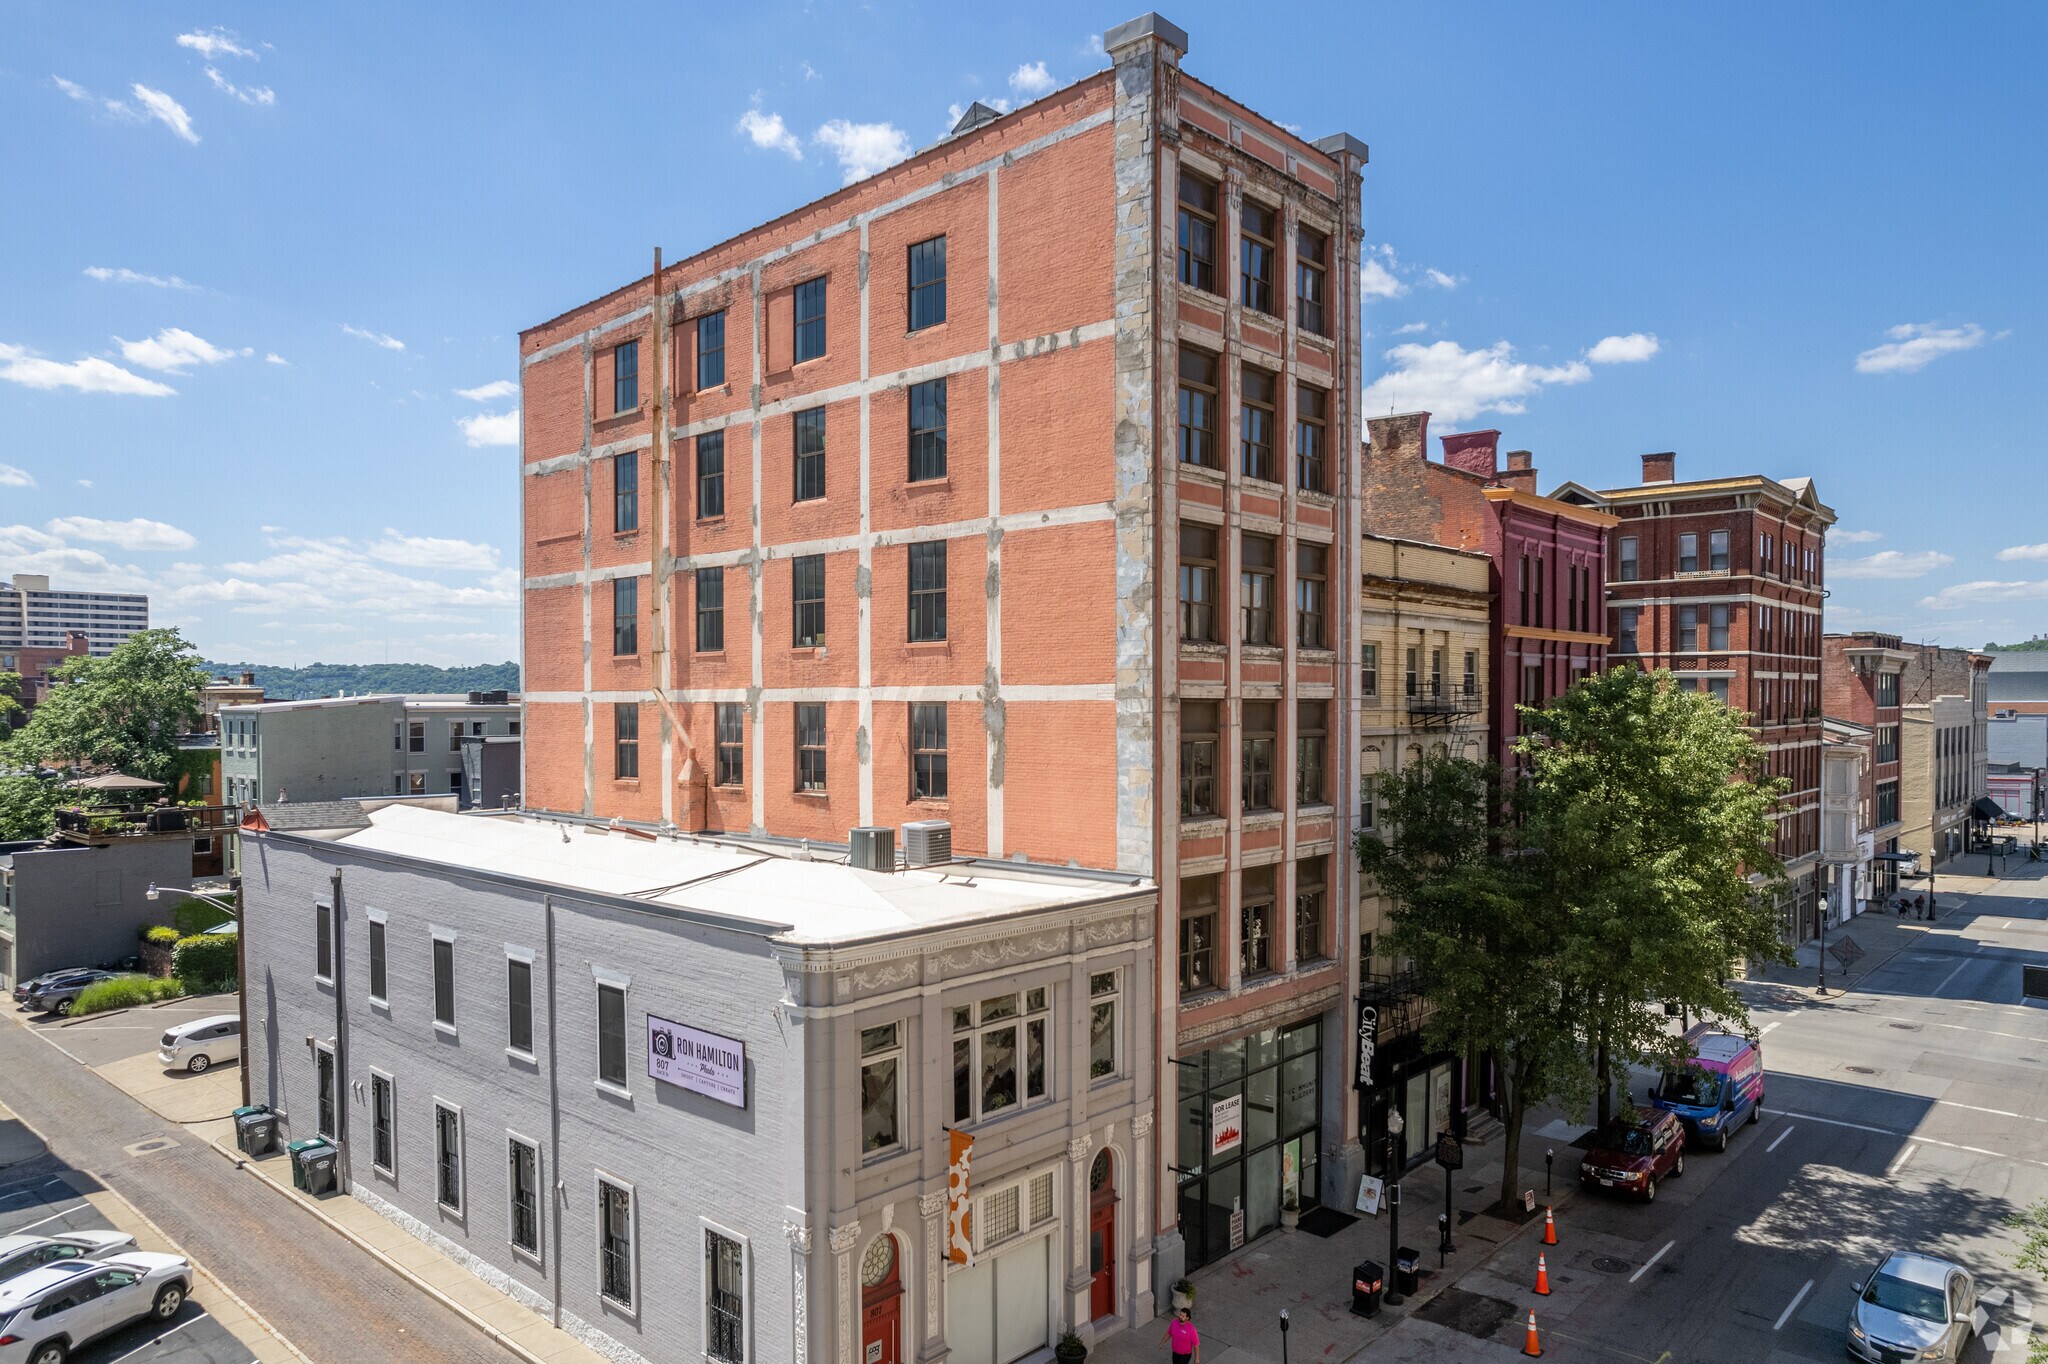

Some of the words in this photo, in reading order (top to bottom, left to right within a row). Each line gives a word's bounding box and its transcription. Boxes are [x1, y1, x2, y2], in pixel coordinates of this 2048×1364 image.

[1359, 1006, 1377, 1086] CityBeat
[677, 1037, 694, 1058] RON
[696, 1042, 739, 1072] HAMILTON
[656, 1058, 669, 1071] 807
[700, 1063, 715, 1076] Photo
[699, 1078, 716, 1089] CAPTURE
[720, 1085, 736, 1095] CREATE
[1215, 1104, 1225, 1114] FOR
[1225, 1098, 1240, 1110] LEASE
[870, 1306, 882, 1318] 807
